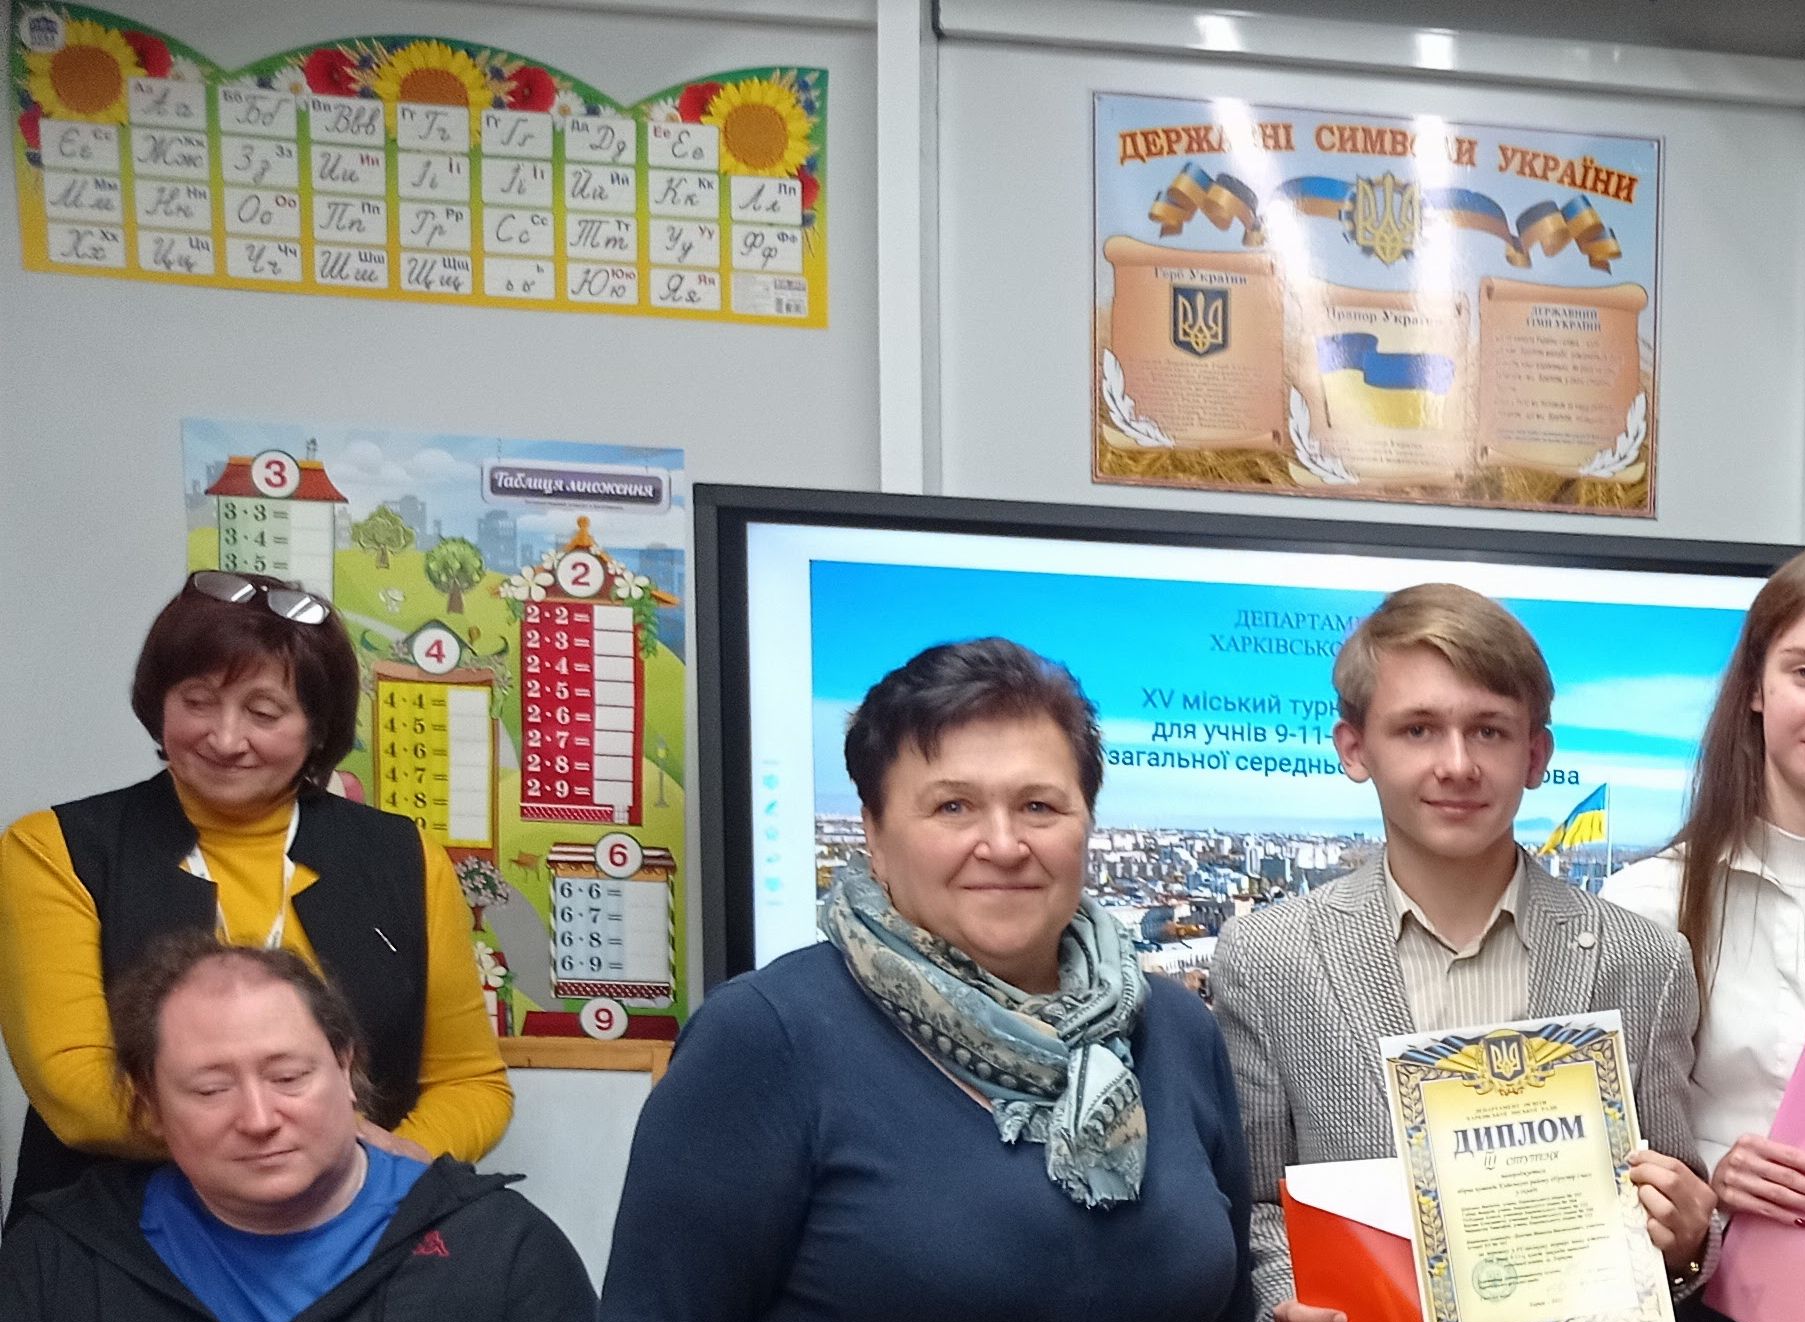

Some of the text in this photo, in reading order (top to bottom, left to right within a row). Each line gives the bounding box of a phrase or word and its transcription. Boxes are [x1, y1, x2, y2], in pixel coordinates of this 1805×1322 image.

[1118, 123, 1638, 204] ДЕРЖНІ СИМВИ УКРАЇНИ
[264, 460, 287, 488] 3
[494, 471, 654, 498] Таблиця множення
[571, 562, 590, 586] 2
[1234, 609, 1358, 633] ДЕПАРТАМ
[424, 639, 446, 664] 4
[1141, 687, 1175, 709] XV
[1182, 691, 1281, 715] міський
[1152, 722, 1196, 741] для
[1204, 722, 1267, 745] учнів
[1108, 749, 1231, 770] загальної
[609, 843, 628, 867] 6
[594, 1008, 614, 1031] 9
[1453, 1114, 1585, 1160] ДИПЛОМ
